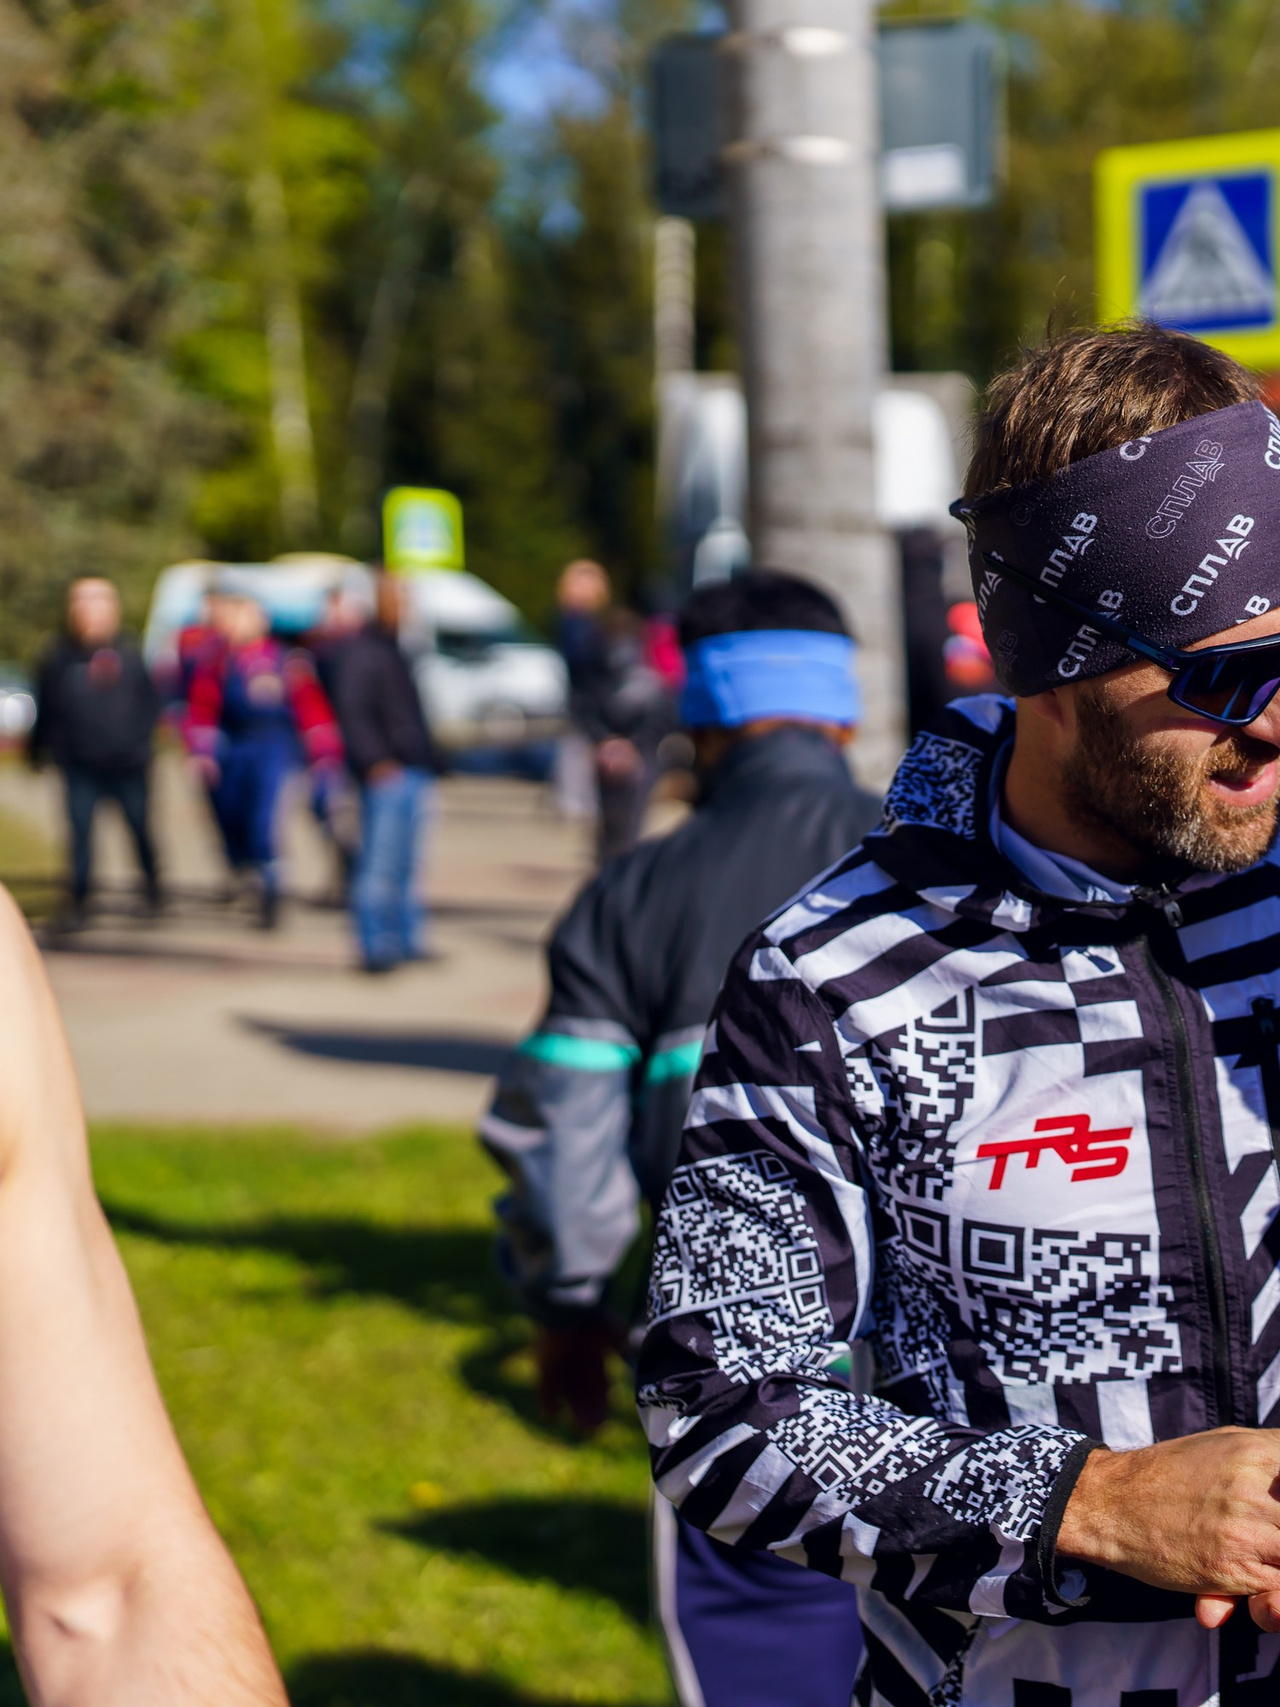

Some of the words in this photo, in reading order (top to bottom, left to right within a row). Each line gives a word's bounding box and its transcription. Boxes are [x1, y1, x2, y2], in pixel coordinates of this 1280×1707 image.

[1120, 437, 1152, 461] С
[1145, 439, 1225, 539] СПЛАВ
[1035, 512, 1098, 604] ПЛАВ
[1170, 514, 1255, 616] СПЛАВ
[1235, 595, 1271, 624] В
[976, 1113, 1133, 1190] TRS
